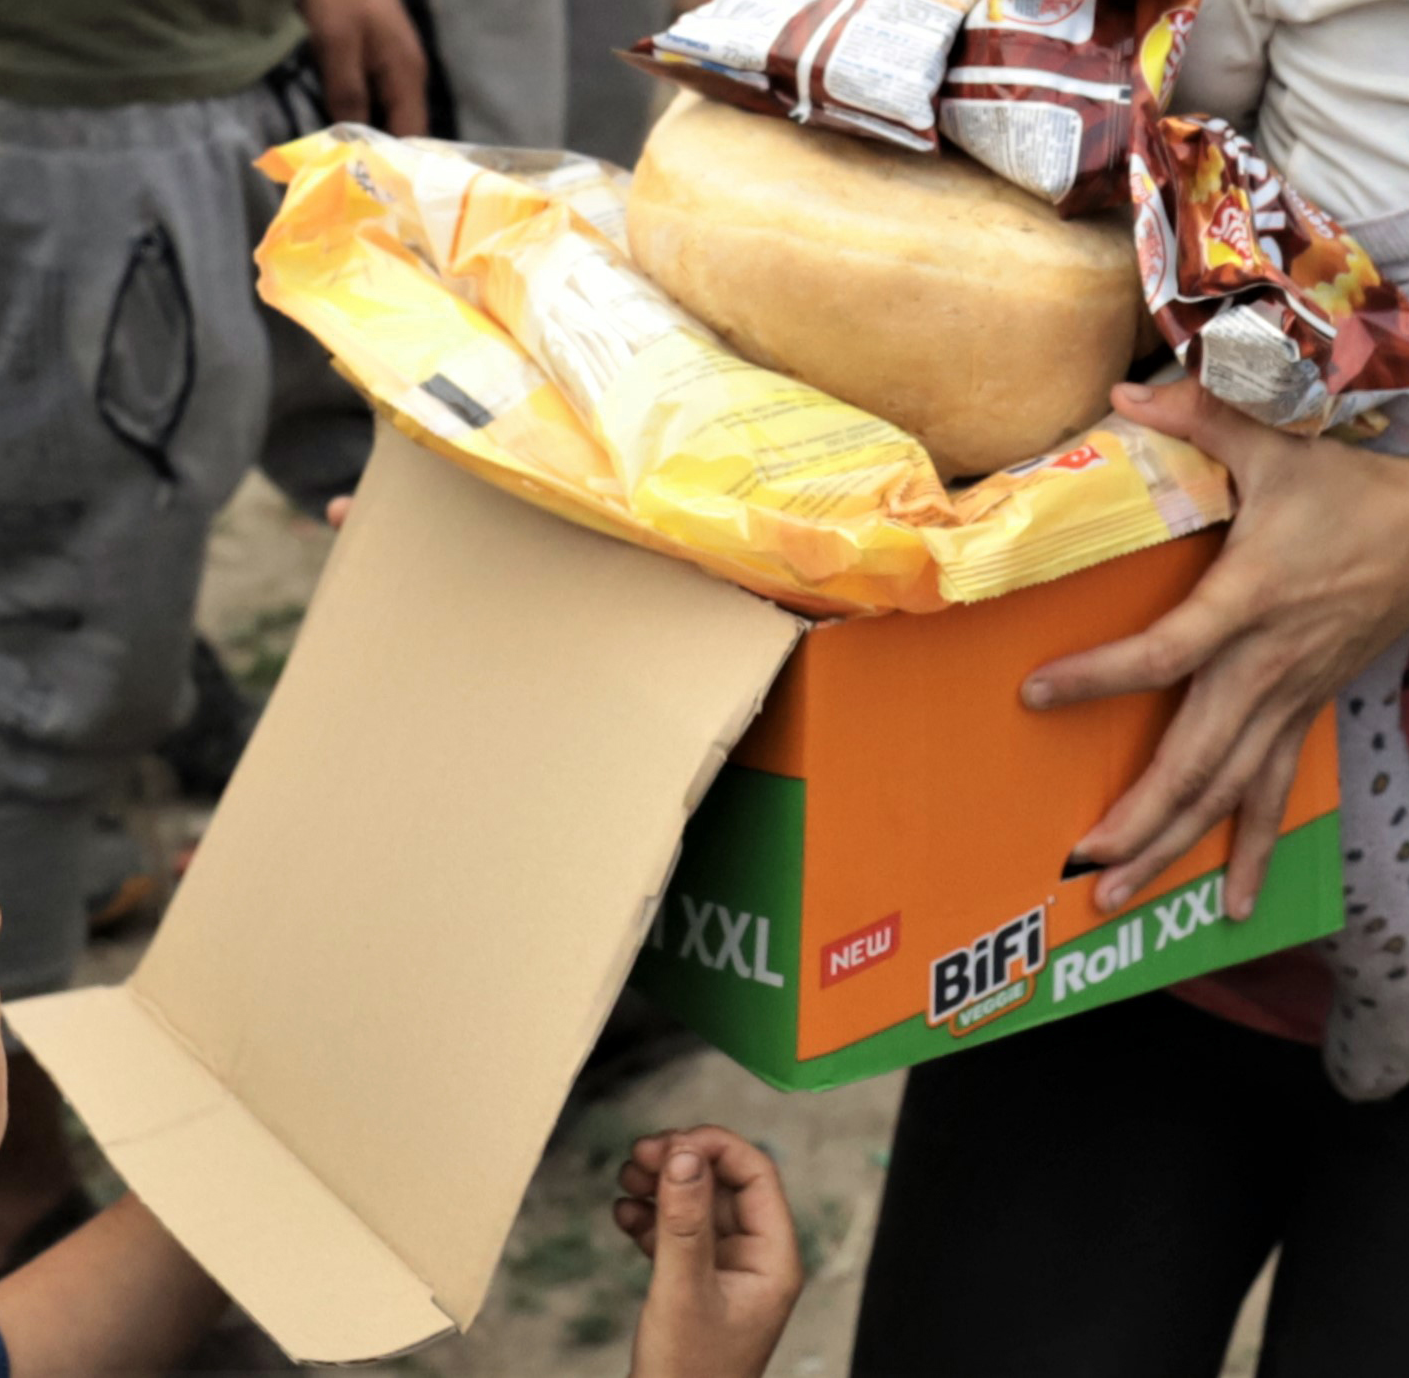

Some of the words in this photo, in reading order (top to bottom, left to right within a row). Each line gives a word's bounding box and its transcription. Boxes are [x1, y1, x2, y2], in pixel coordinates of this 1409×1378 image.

[680, 893, 785, 989] XXL
[829, 926, 892, 977] NEW
[931, 906, 1045, 1023] BiFi
[1052, 917, 1143, 1004] Roll
[957, 979, 1027, 1027] VEGGIE
